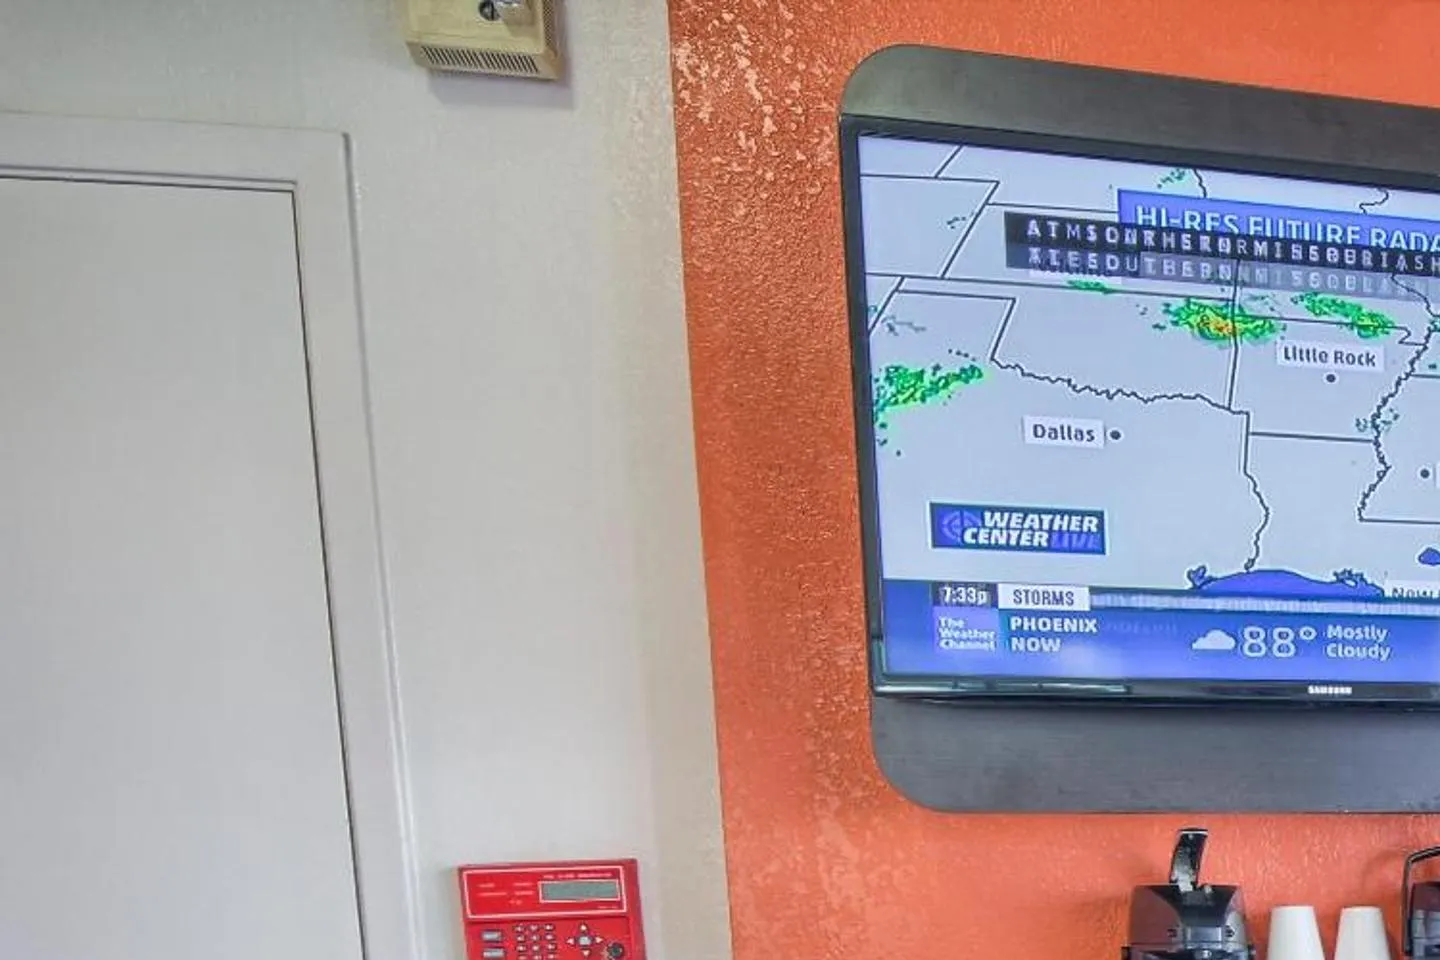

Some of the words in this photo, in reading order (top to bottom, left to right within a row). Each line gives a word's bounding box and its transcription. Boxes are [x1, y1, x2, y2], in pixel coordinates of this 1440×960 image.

[1283, 347, 1329, 364] Little
[1333, 350, 1376, 368] Rock
[1032, 423, 1096, 443] Dallas
[982, 511, 1099, 532] WEATHER
[963, 526, 1049, 547] CENTER
[1012, 588, 1075, 606] STORMS
[938, 616, 965, 628] The
[1010, 616, 1099, 633] PHOENIX
[938, 628, 996, 640] Weather
[1326, 624, 1388, 643] Mostly
[1010, 637, 1062, 652] NOW
[1326, 642, 1391, 660] Cloudy
